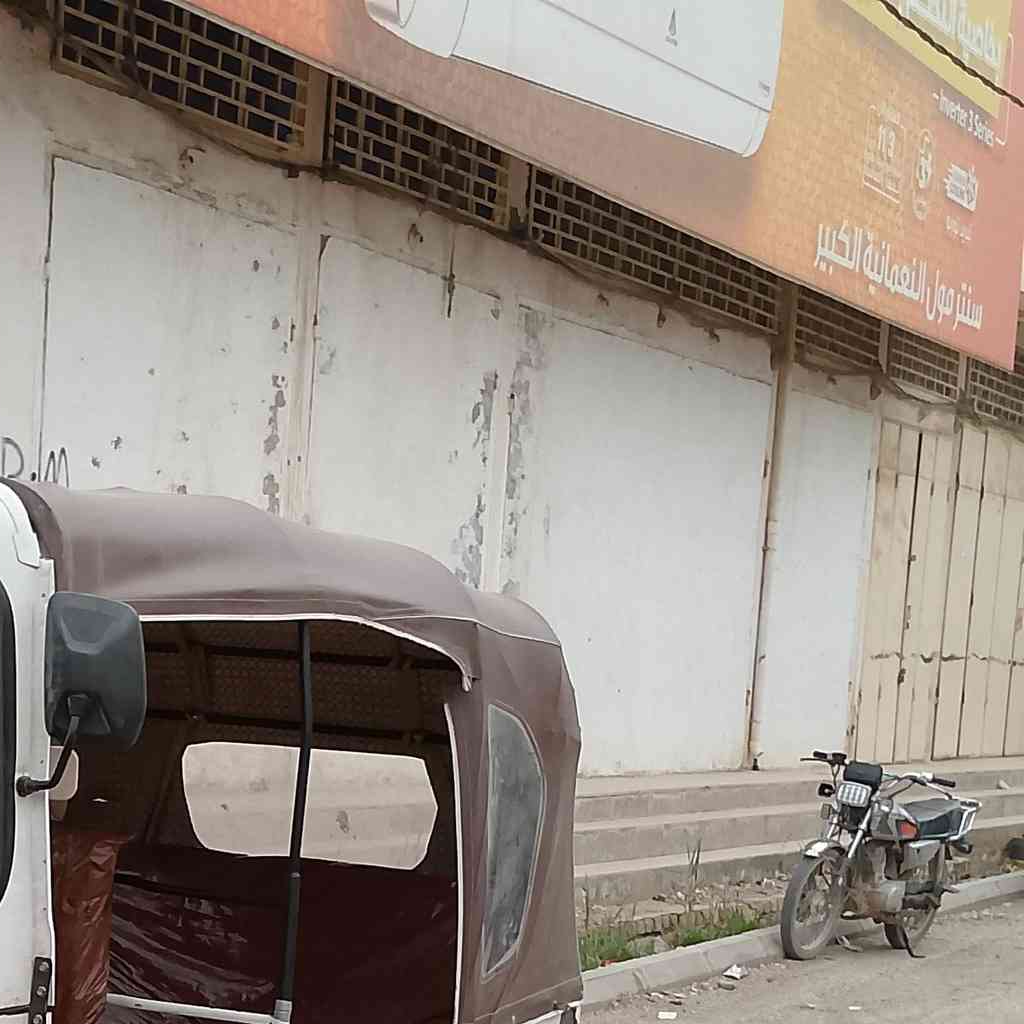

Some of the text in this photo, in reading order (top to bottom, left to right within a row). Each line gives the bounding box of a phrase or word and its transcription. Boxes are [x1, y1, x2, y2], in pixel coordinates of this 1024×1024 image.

[939, 88, 967, 130] Inverter
[973, 113, 994, 148] Series
[813, 219, 984, 331] سنتر مول النعمانية الكبير
